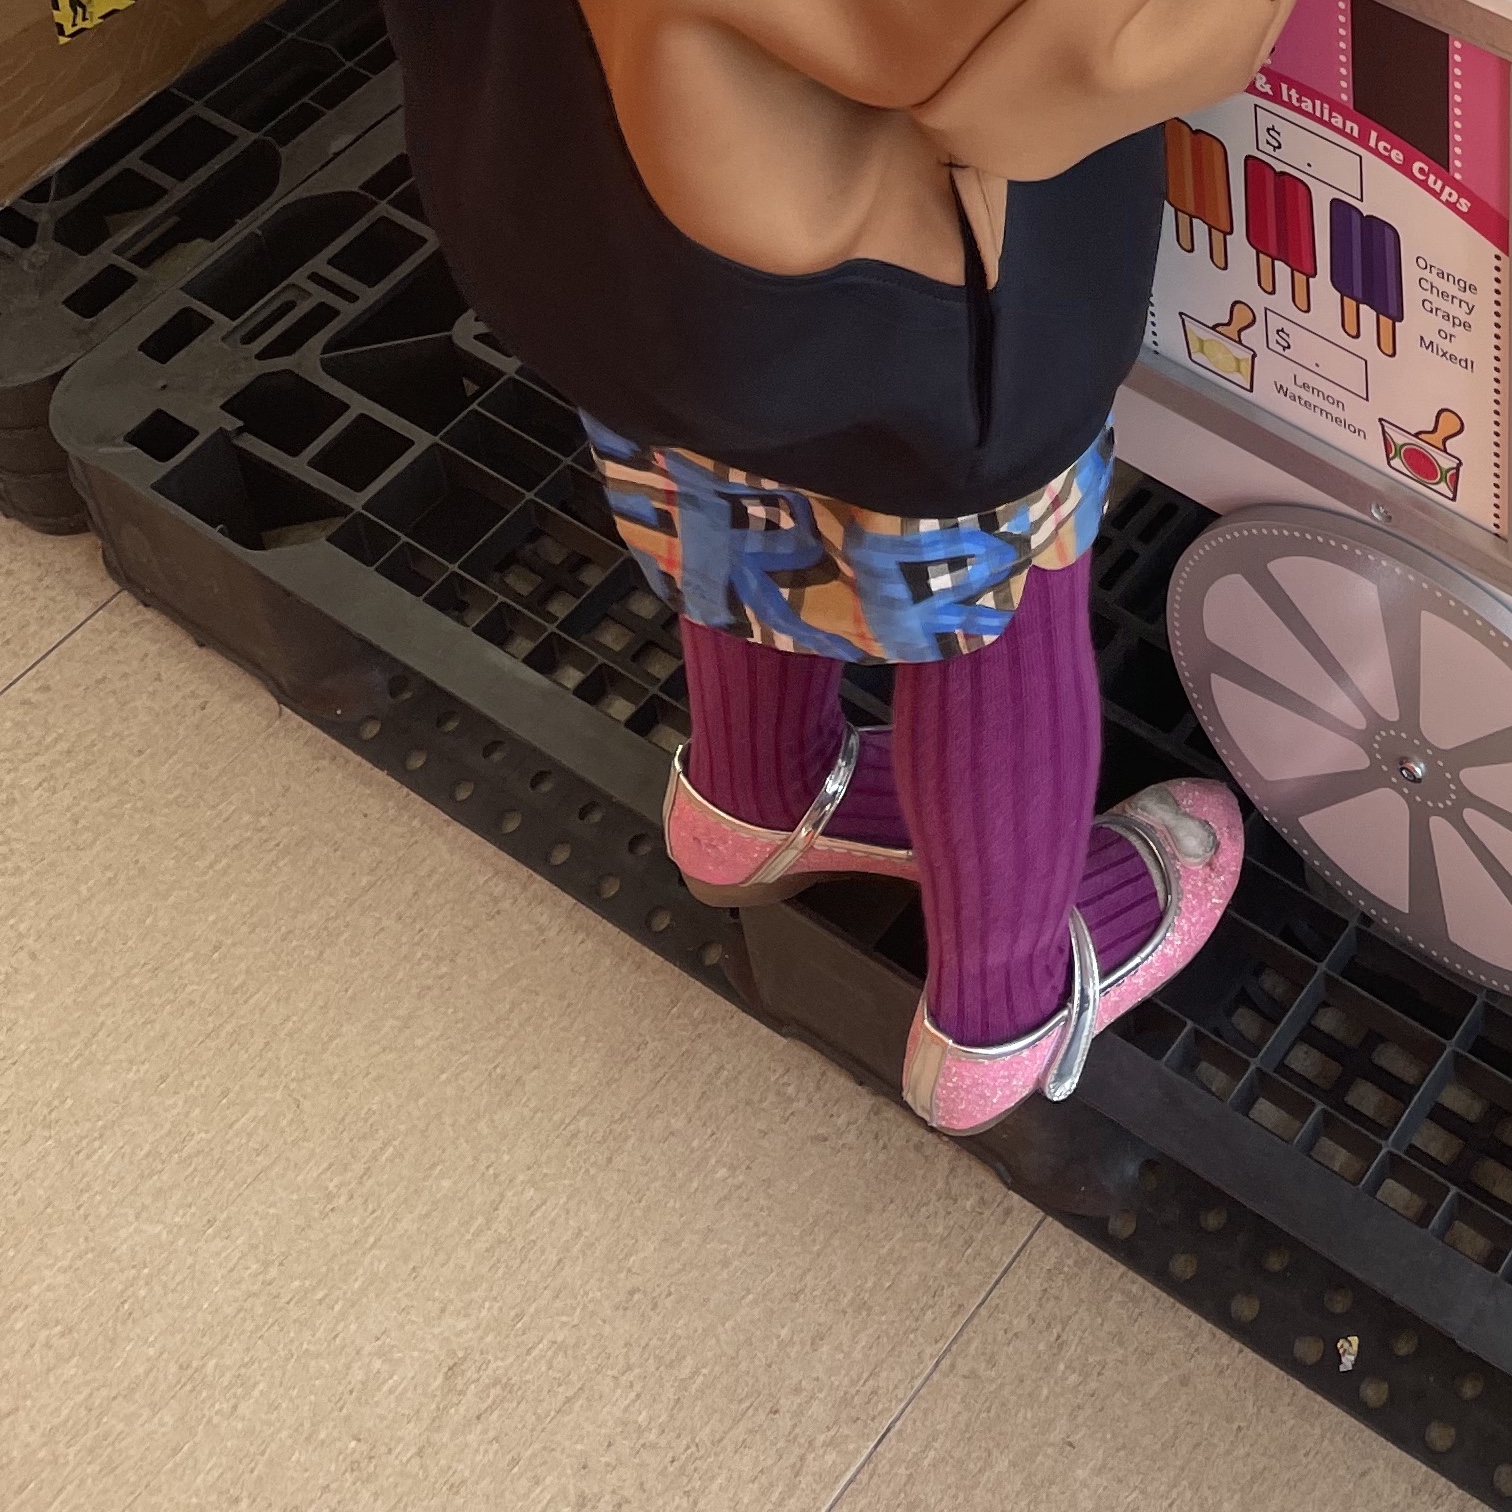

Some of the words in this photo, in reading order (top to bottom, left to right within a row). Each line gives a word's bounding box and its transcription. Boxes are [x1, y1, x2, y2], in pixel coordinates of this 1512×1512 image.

[1254, 72, 1274, 96] &
[1280, 82, 1360, 140] Italian
[1368, 129, 1405, 166] Ice
[1411, 160, 1472, 214] Cups
[1415, 255, 1478, 296] Orange
[1418, 276, 1476, 316] Cherry
[1421, 298, 1472, 333] Grape
[1419, 334, 1475, 374] Mixed!
[1437, 328, 1456, 344] or
[1273, 379, 1368, 441] Watermelon
[1293, 373, 1346, 412] Lemon
